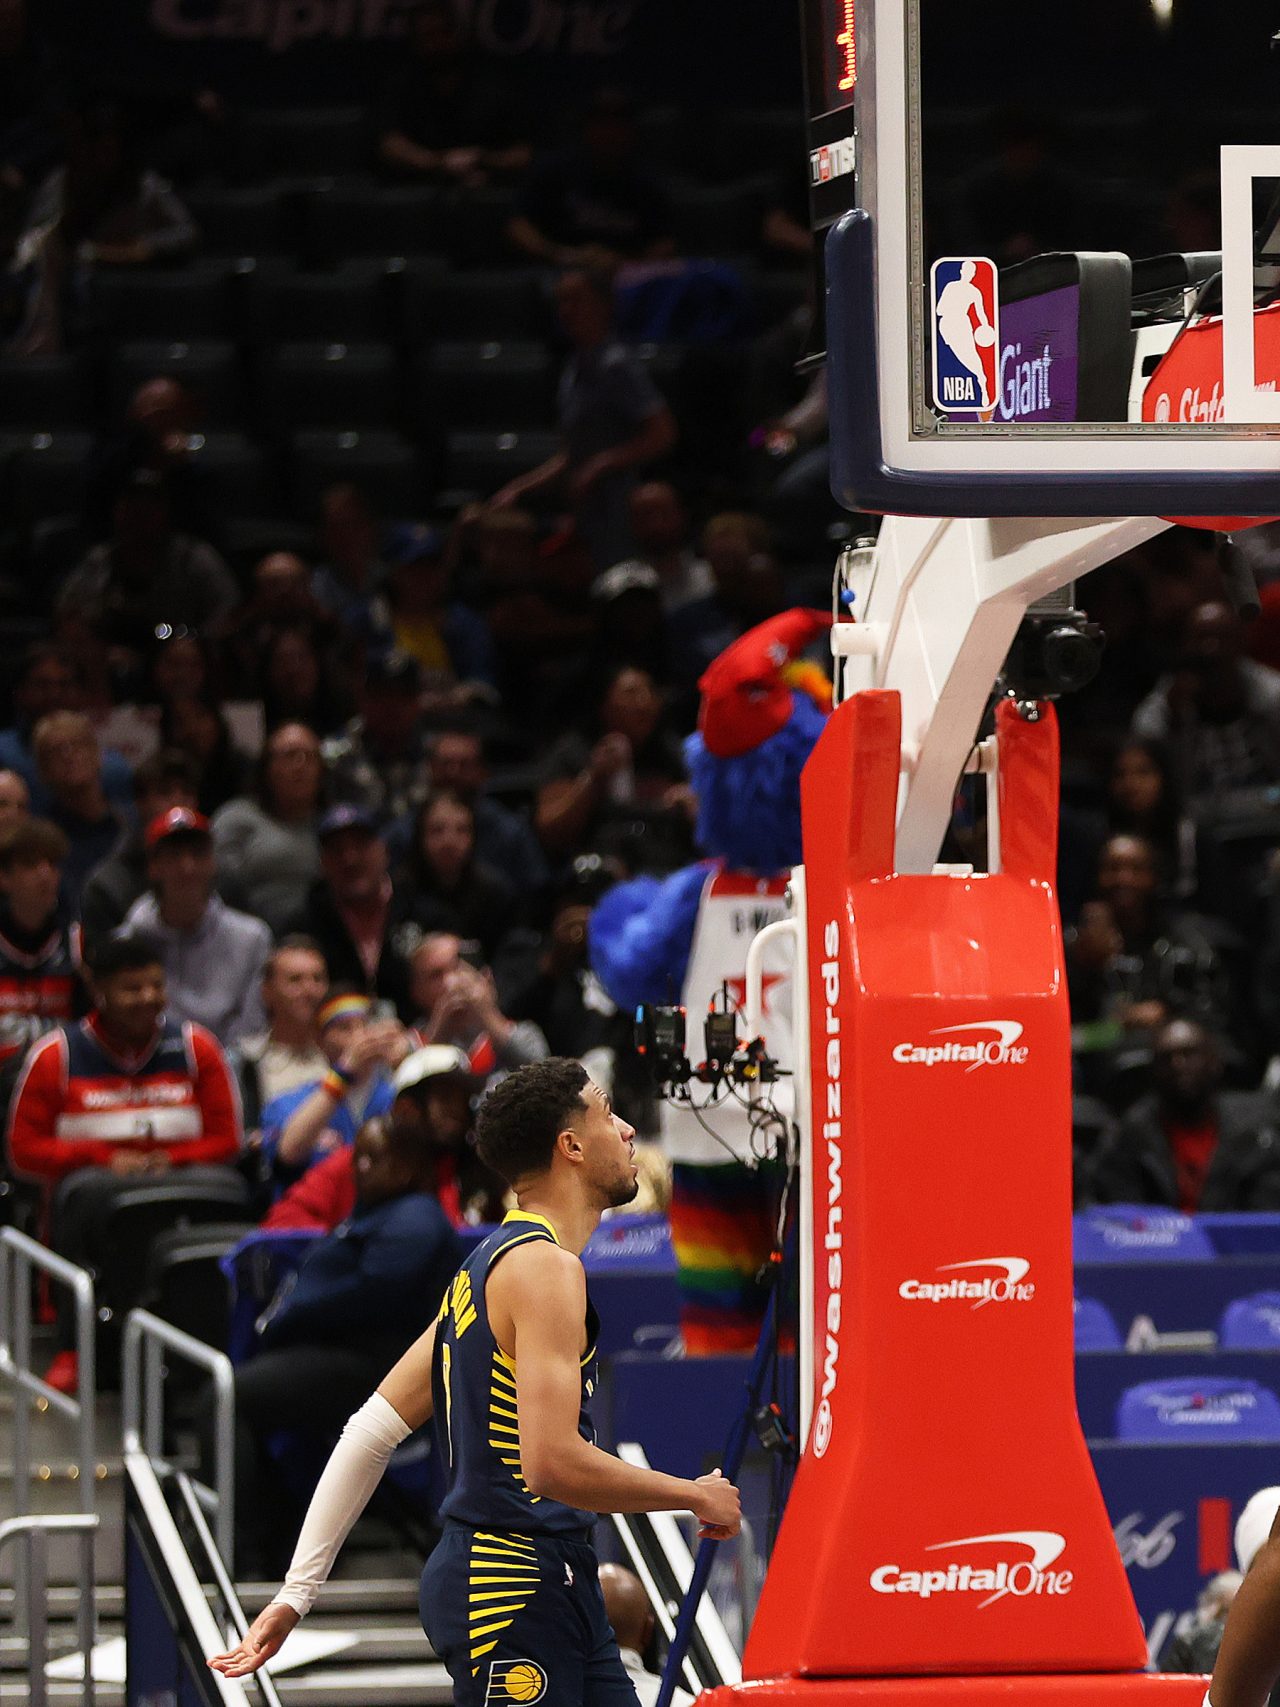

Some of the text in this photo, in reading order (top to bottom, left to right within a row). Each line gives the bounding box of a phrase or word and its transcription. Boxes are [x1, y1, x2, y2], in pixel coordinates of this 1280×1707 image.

[943, 376, 976, 401] NBA
[1000, 342, 1052, 420] Giant
[812, 918, 840, 1460] @washwizards
